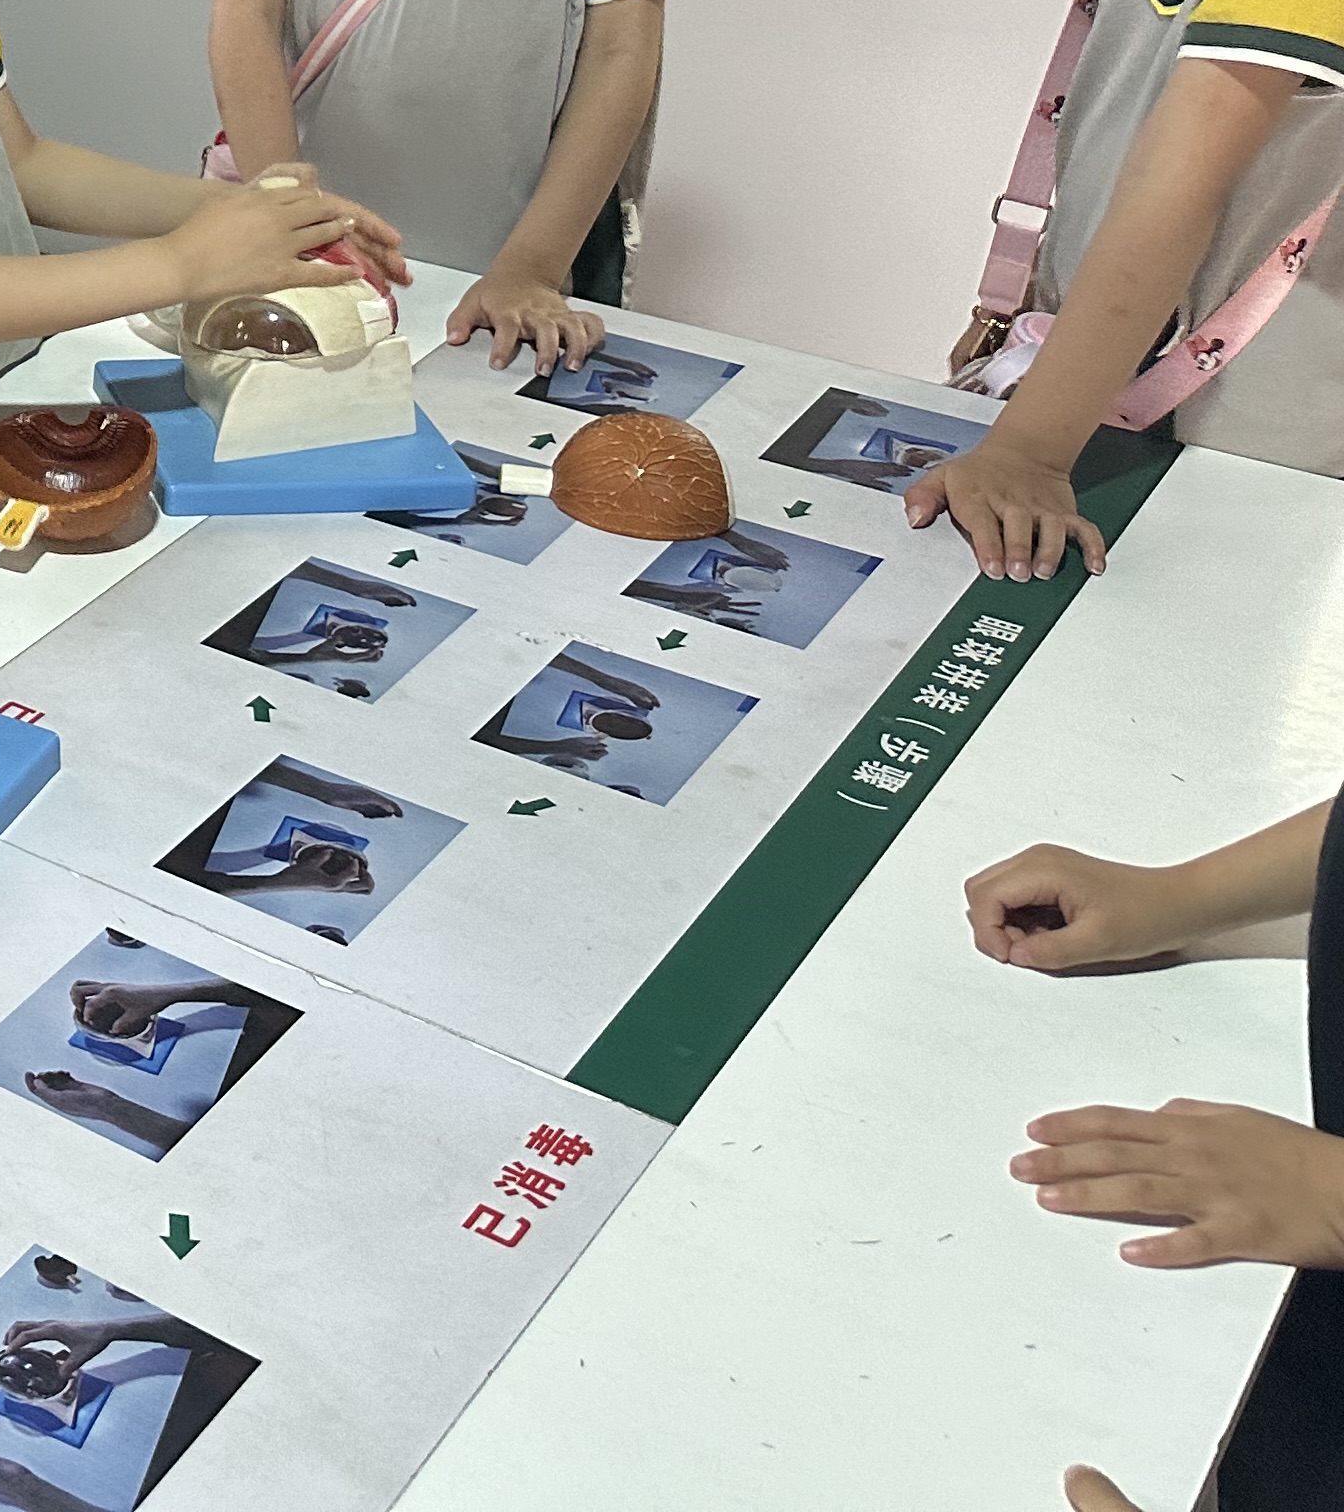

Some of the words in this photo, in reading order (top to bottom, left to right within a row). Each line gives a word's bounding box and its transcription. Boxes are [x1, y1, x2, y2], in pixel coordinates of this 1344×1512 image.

[837, 614, 1025, 811] 眼球拼装（步骤）
[461, 1123, 594, 1250] 已消毒
